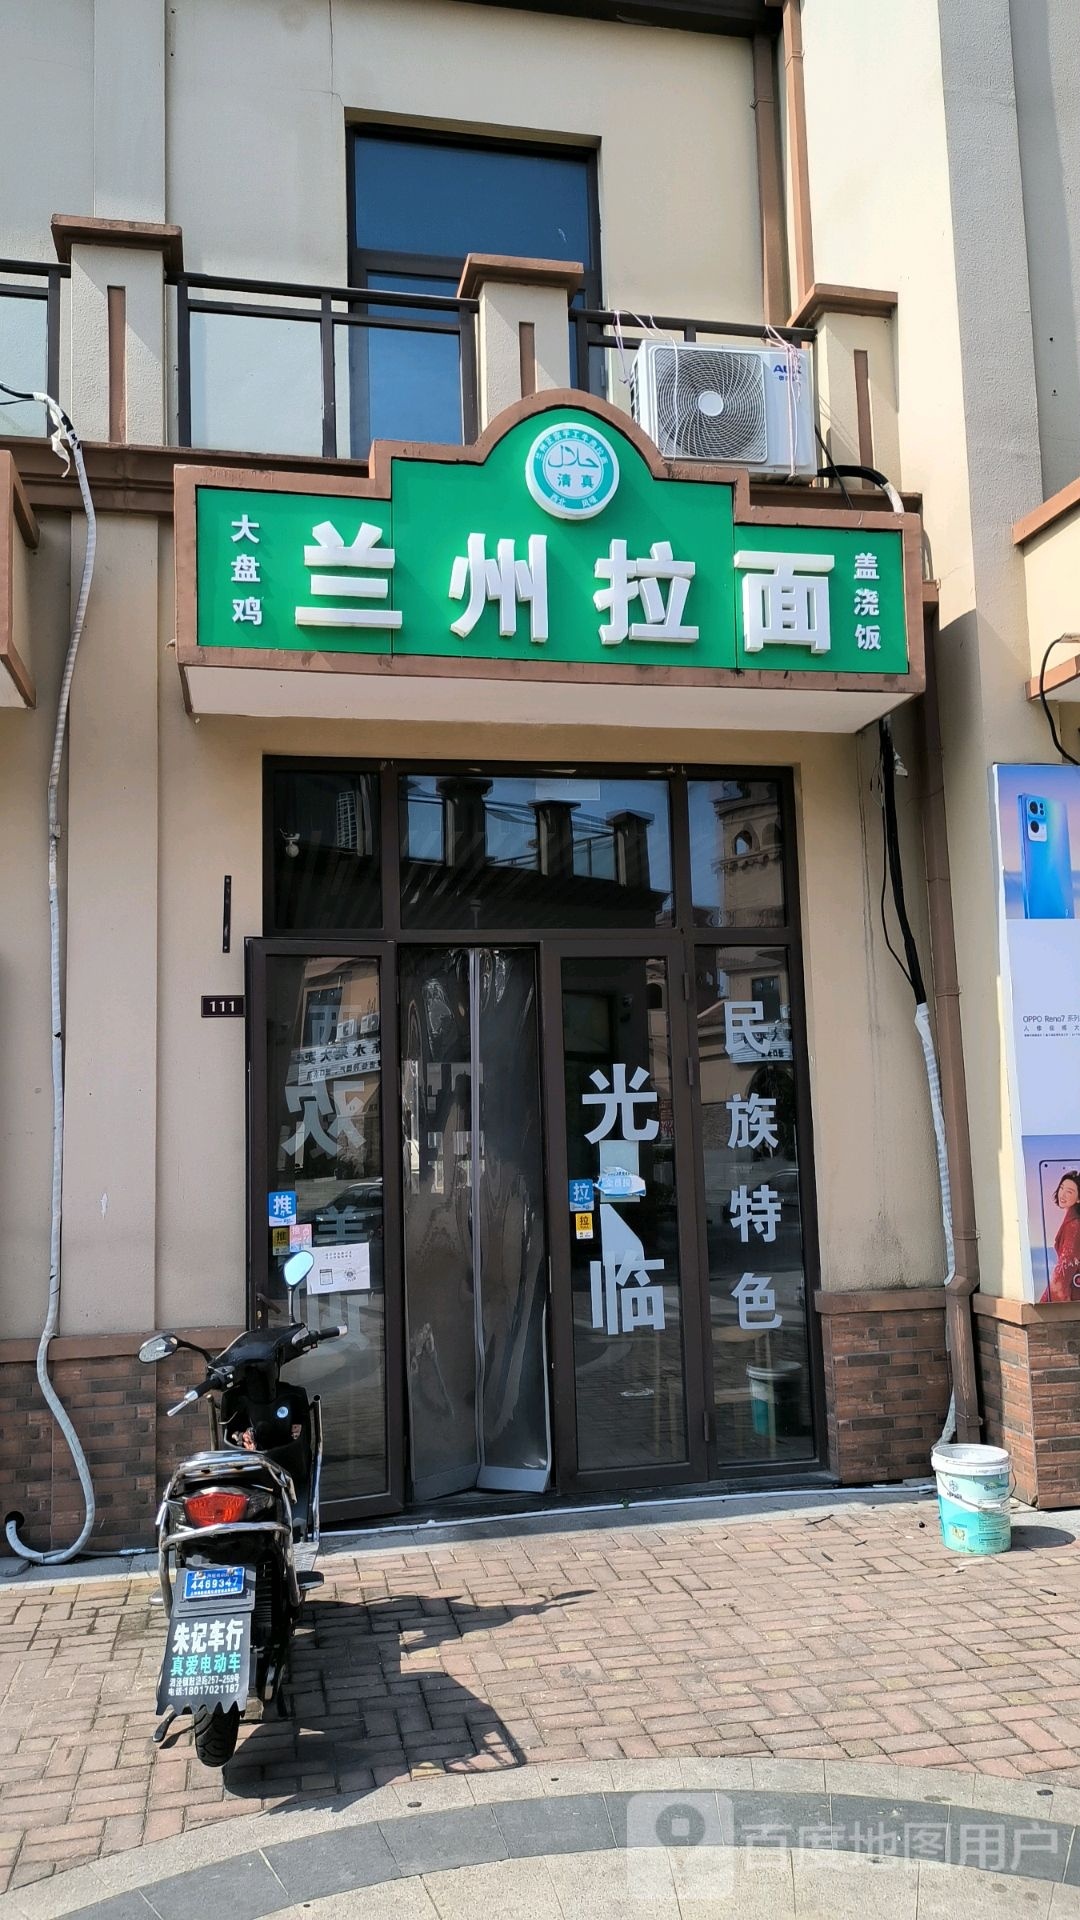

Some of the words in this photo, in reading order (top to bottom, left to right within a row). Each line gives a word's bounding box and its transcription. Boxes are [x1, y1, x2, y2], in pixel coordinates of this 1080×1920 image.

[557, 472, 594, 488] 清真
[230, 513, 263, 626] 大盘鸡
[294, 520, 836, 655] 兰州拉面
[853, 552, 881, 650] 盖浇饭
[209, 1000, 235, 1012] 111
[1022, 1015, 1043, 1023] OPPO
[1044, 1014, 1066, 1023] Reno7
[724, 1000, 783, 1331] 民族特色
[573, 1182, 590, 1202] 拉
[172, 1618, 244, 1655] 朱记车行
[170, 1652, 241, 1677] 真爱电动车
